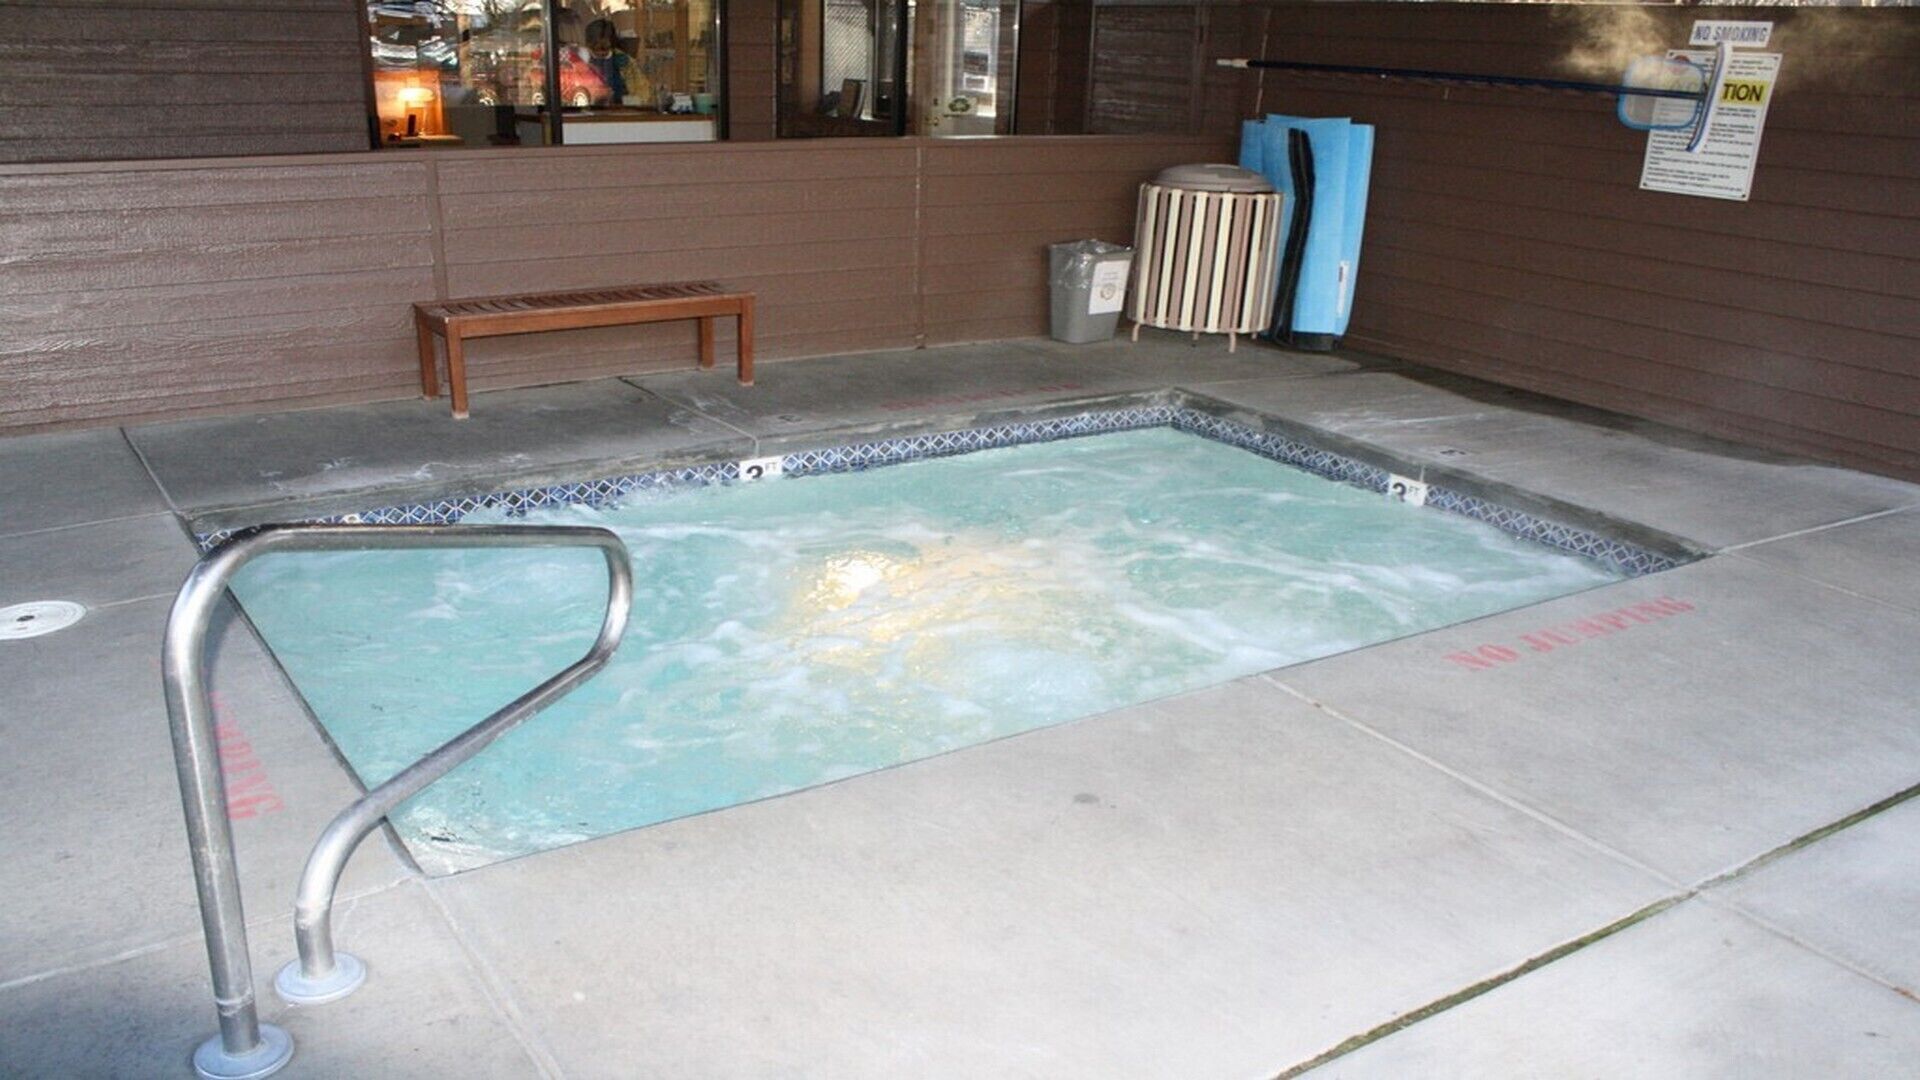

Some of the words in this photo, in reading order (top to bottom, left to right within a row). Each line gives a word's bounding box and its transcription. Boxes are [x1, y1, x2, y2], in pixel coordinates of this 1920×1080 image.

[1694, 26, 1711, 40] NO
[1713, 26, 1768, 42] SMOKING
[1703, 82, 1764, 101] TION
[1442, 644, 1519, 671] NO
[1519, 596, 1695, 653] JUMPING
